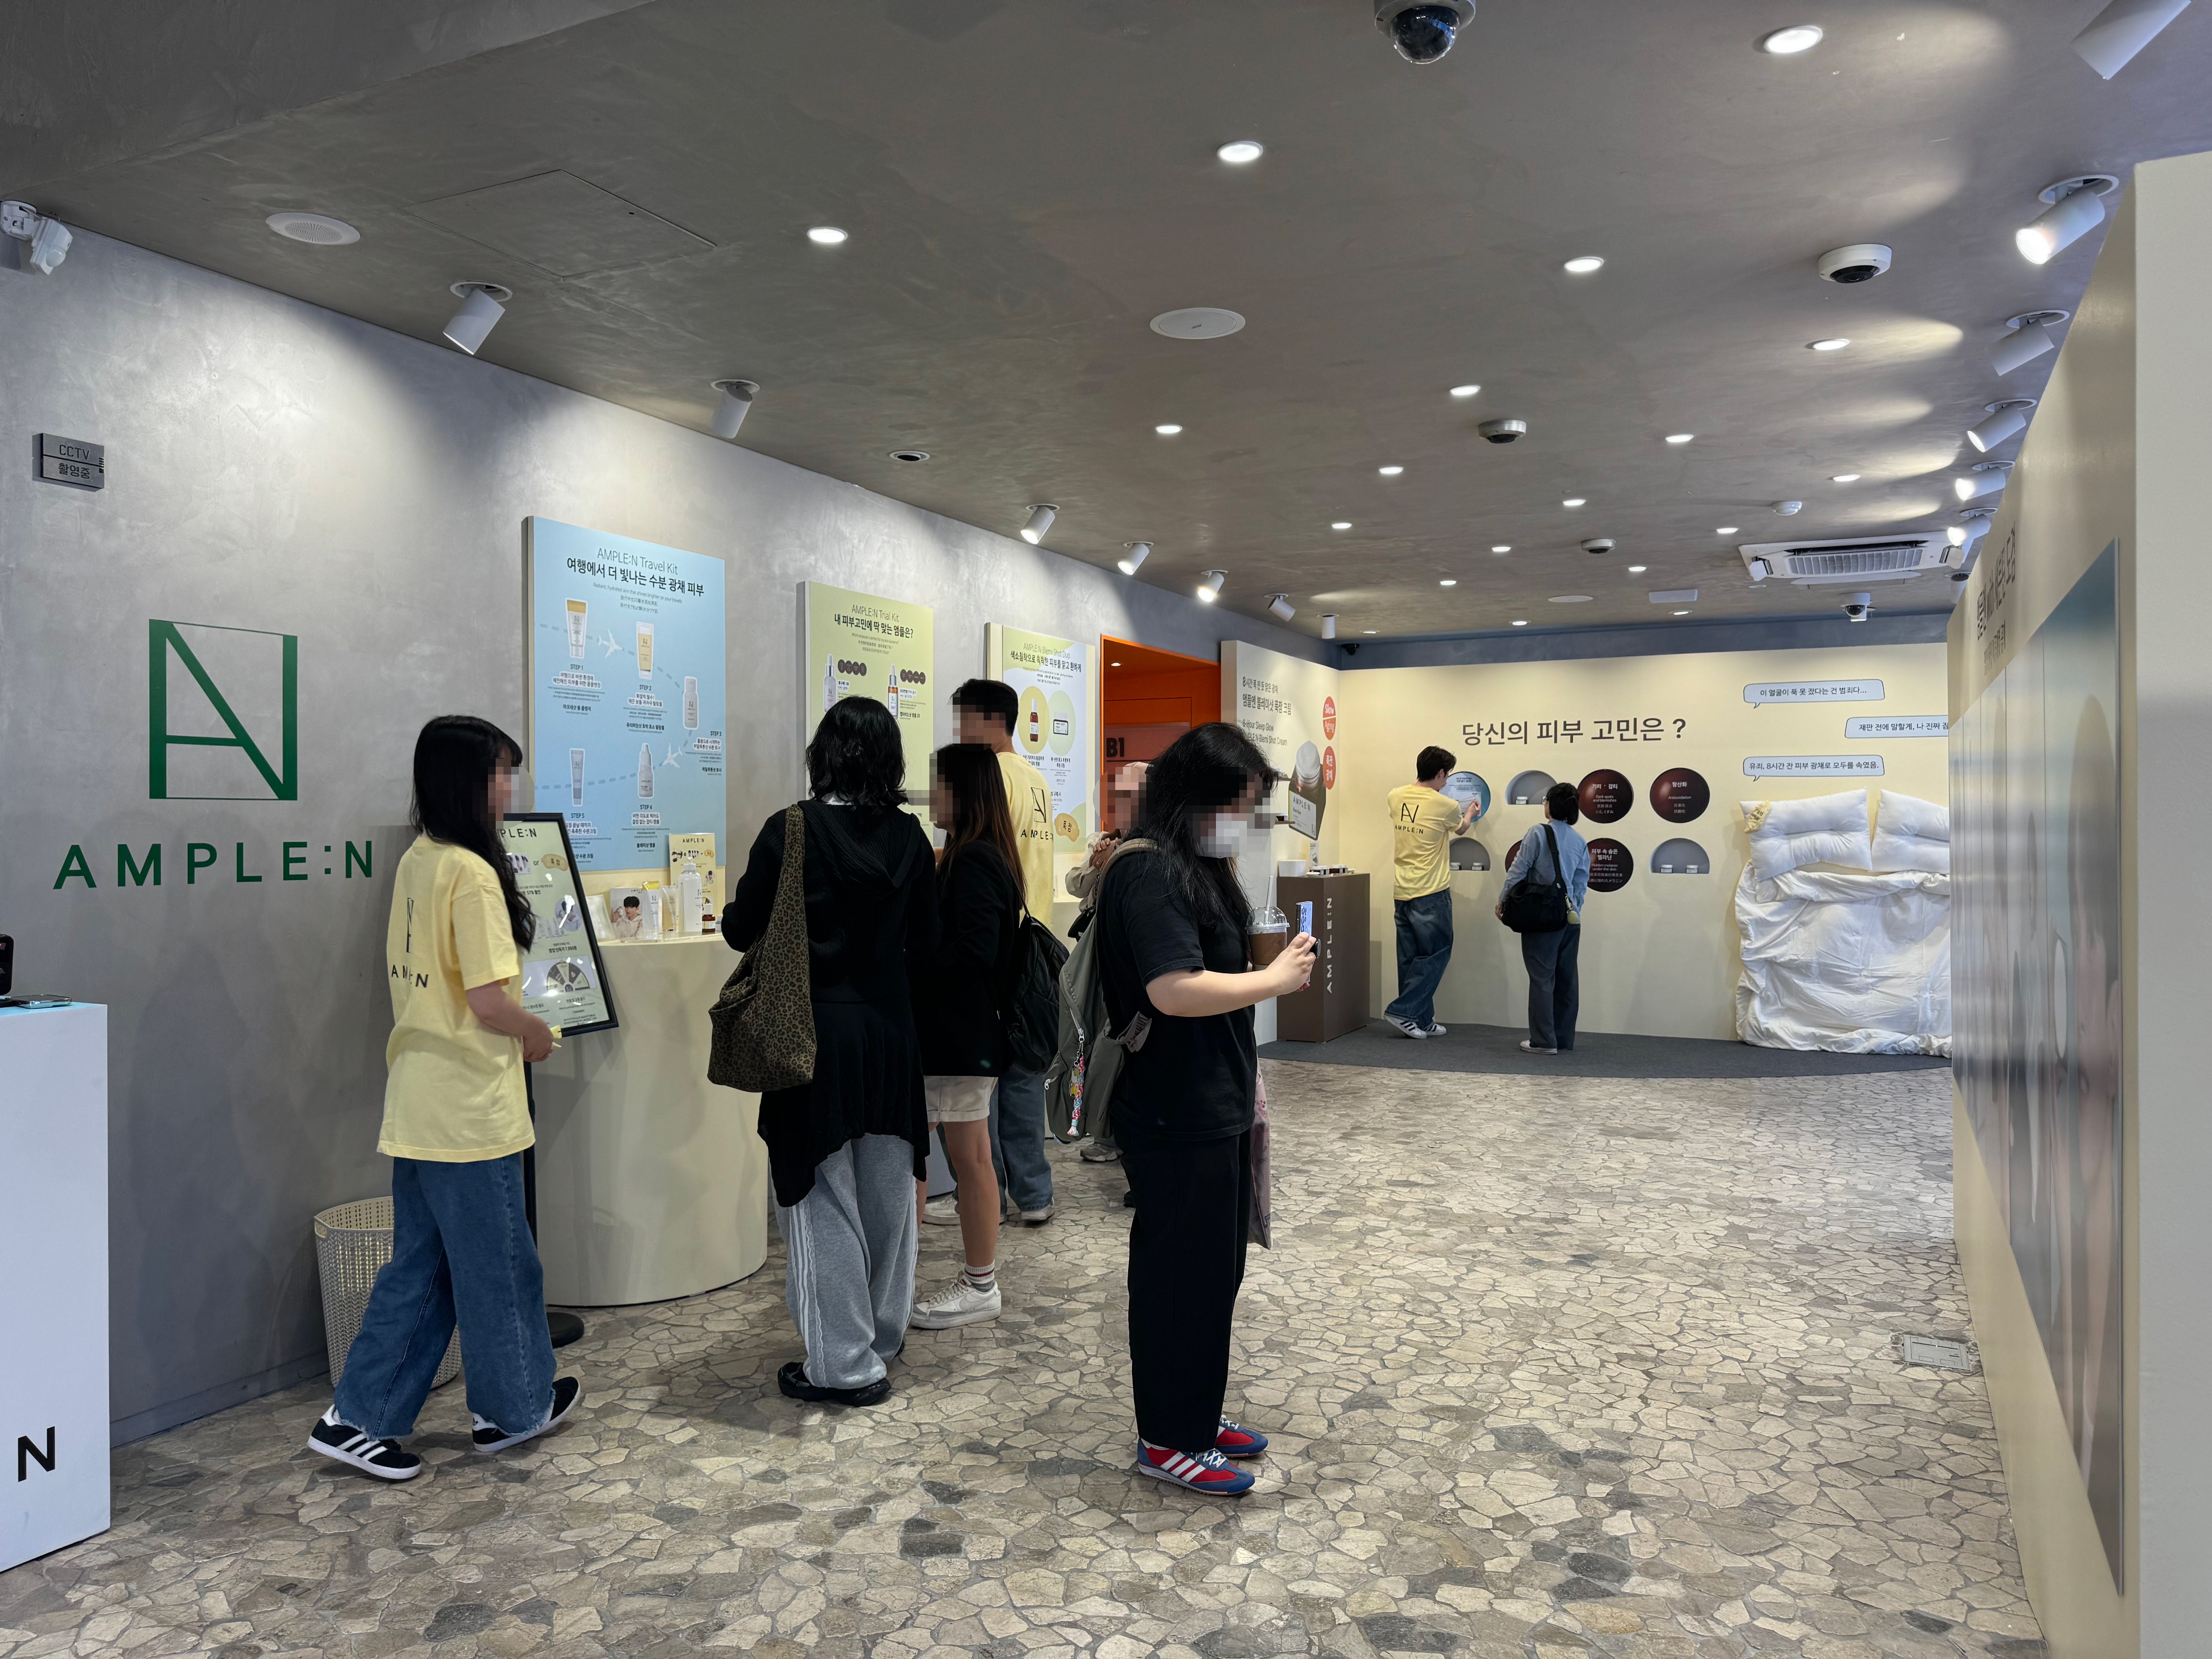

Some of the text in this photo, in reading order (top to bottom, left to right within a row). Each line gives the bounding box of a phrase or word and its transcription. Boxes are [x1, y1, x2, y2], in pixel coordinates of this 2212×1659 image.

[59, 445, 89, 460] CCTV
[58, 463, 90, 479] 촬영중
[597, 548, 678, 575] AMPLE:N Travel Kit
[567, 558, 704, 597] 여행에서 더 빛나는 수분 광채 피부
[852, 604, 878, 618] AMPLE:N
[879, 610, 891, 620] Trial
[835, 613, 913, 638] 내 피부고민에 딱 맞는 앰플은?
[1024, 643, 1042, 653] AMPLE:N
[1042, 646, 1053, 654] Blemi
[1054, 649, 1062, 657] Shot
[1049, 658, 1061, 669] 피부를
[1070, 662, 1081, 672] 환하게
[1243, 677, 1253, 688] 8시간
[1243, 694, 1291, 715] 앰플엔 블레미샷 푹잠 크림
[1324, 703, 1334, 715] Slow
[1255, 721, 1265, 732] Sleep
[1266, 723, 1274, 732] Glow
[1324, 720, 1335, 733] Aging
[1463, 718, 1686, 746] 당신의 피부 고민은 ?
[1859, 723, 1874, 732] 재판
[1106, 737, 1124, 757] B1
[1259, 734, 1268, 743] Blemi
[1276, 737, 1287, 746] Cream
[1293, 796, 1310, 811] AMPLE:N
[498, 828, 537, 838] PLE:N
[1395, 824, 1424, 834] AMPLE:N
[53, 841, 373, 890] AMPLE:N
[18, 1426, 56, 1482] N
